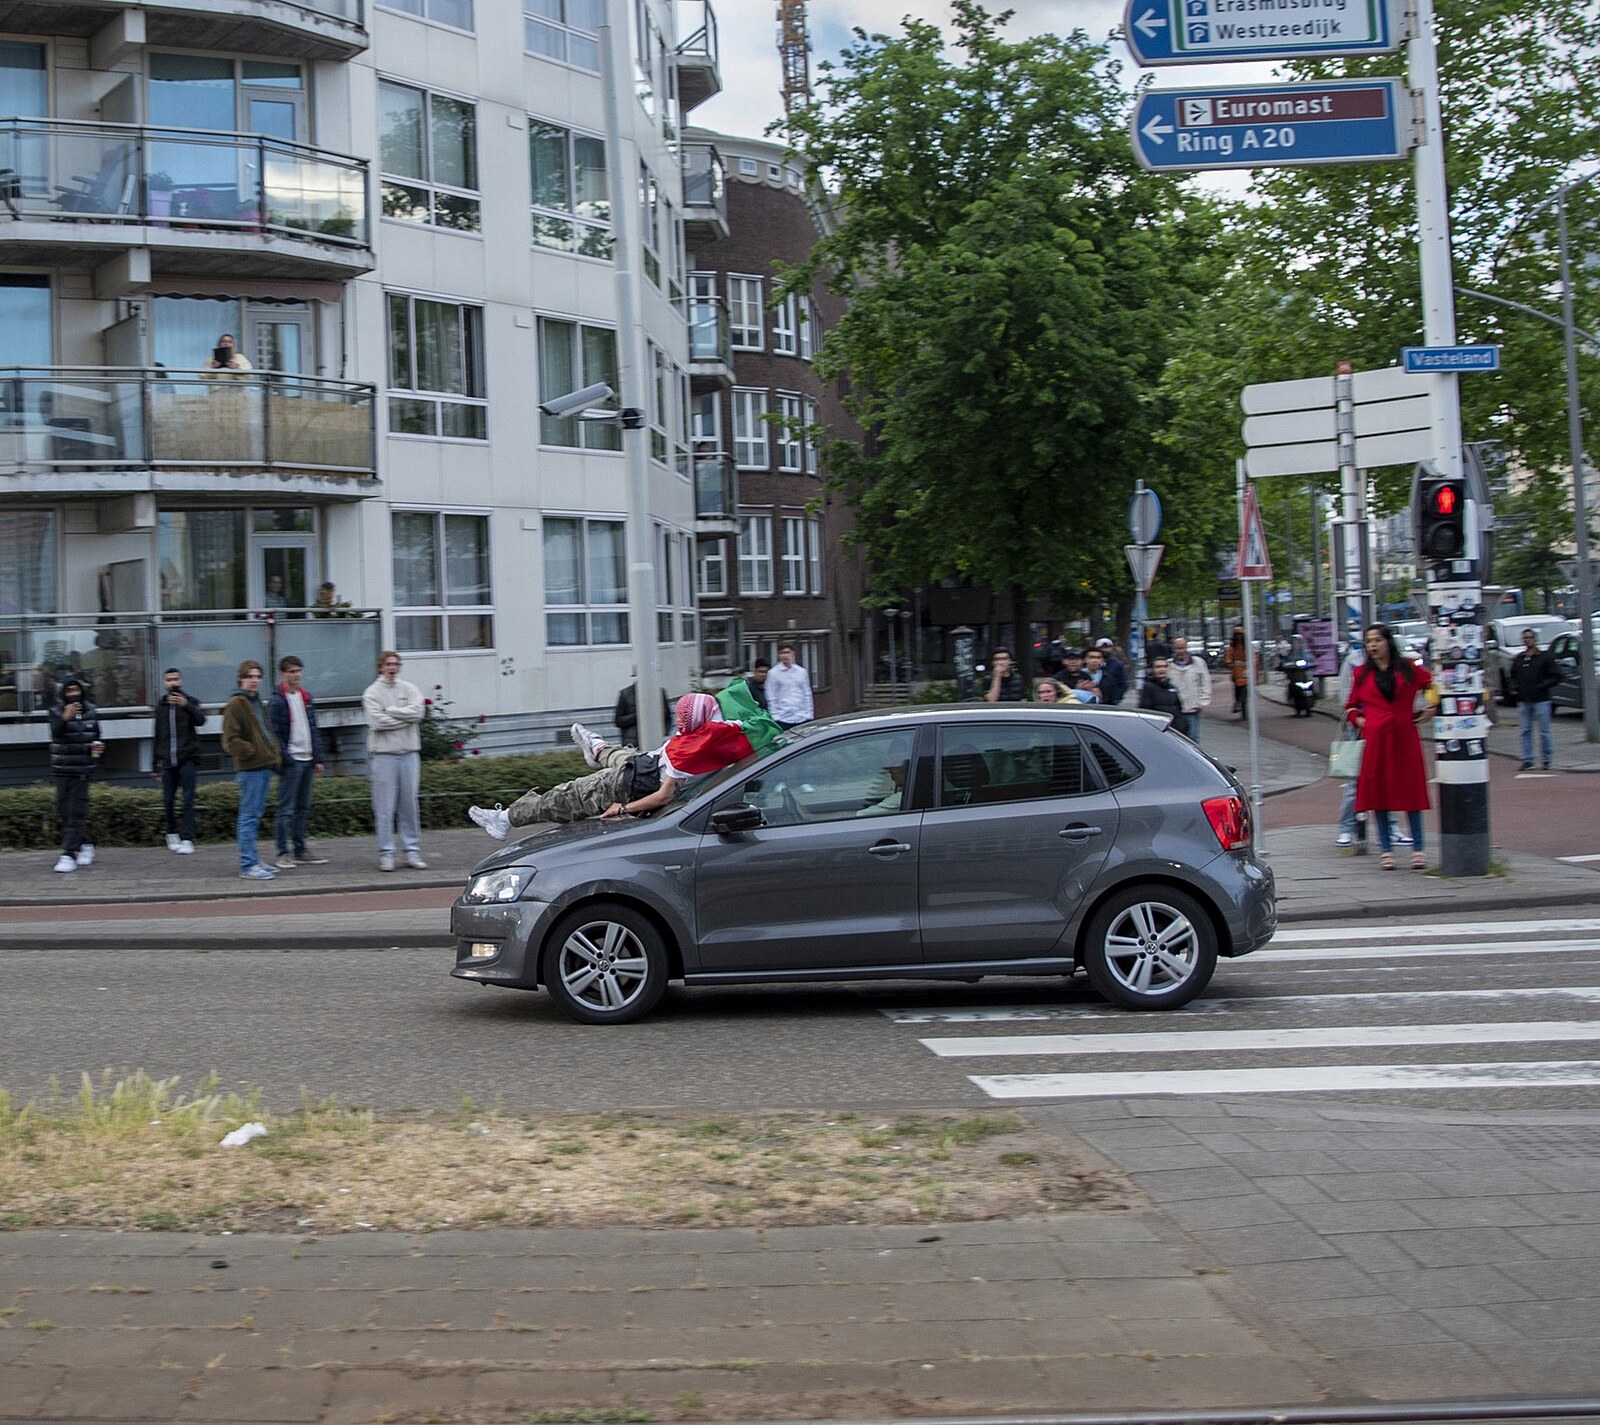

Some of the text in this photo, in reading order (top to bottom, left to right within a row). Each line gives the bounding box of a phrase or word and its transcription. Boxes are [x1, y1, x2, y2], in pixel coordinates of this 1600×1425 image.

[1216, 19, 1342, 39] Westzeedijk
[1216, 96, 1334, 118] Euromast
[1177, 127, 1296, 155] Ring A20
[1411, 351, 1492, 366] Vasteland
